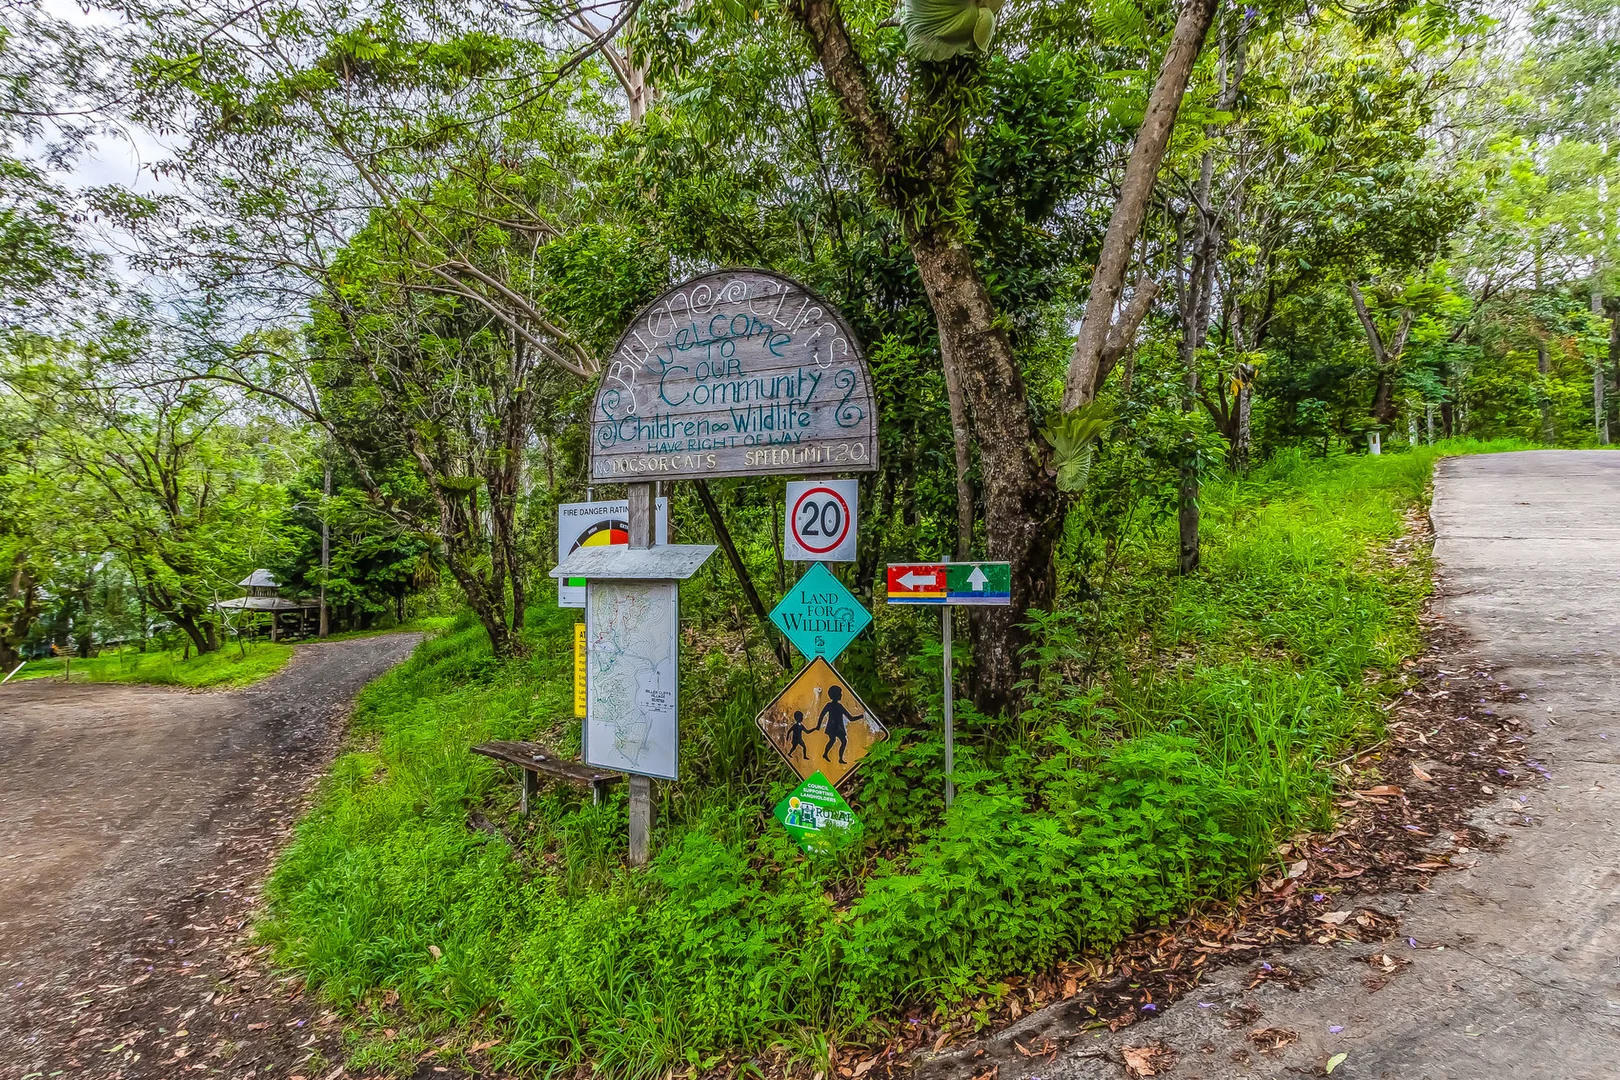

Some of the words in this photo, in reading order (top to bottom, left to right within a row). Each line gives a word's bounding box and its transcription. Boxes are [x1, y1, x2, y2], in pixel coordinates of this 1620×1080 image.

[749, 279, 848, 369] CLIFFS
[699, 338, 735, 360] TO
[695, 358, 746, 381] OUR
[660, 366, 822, 408] Community
[618, 412, 709, 442] Children
[730, 398, 811, 433] Wildlife
[688, 435, 738, 451] RIGHT
[744, 434, 763, 446] OF
[769, 431, 803, 445] WAY
[594, 460, 611, 475] NO
[648, 456, 668, 471] OR
[671, 453, 716, 469] CATS
[744, 448, 790, 466] SPEED
[580, 507, 608, 516] DANGER
[801, 500, 841, 537] 20
[801, 591, 839, 605] LAND
[807, 606, 834, 617] FOR
[782, 613, 855, 633] WILDLIFE
[800, 792, 836, 802] LANDHOLDERS
[803, 787, 834, 797] SUPPORTING
[807, 783, 829, 791] COUNCIL
